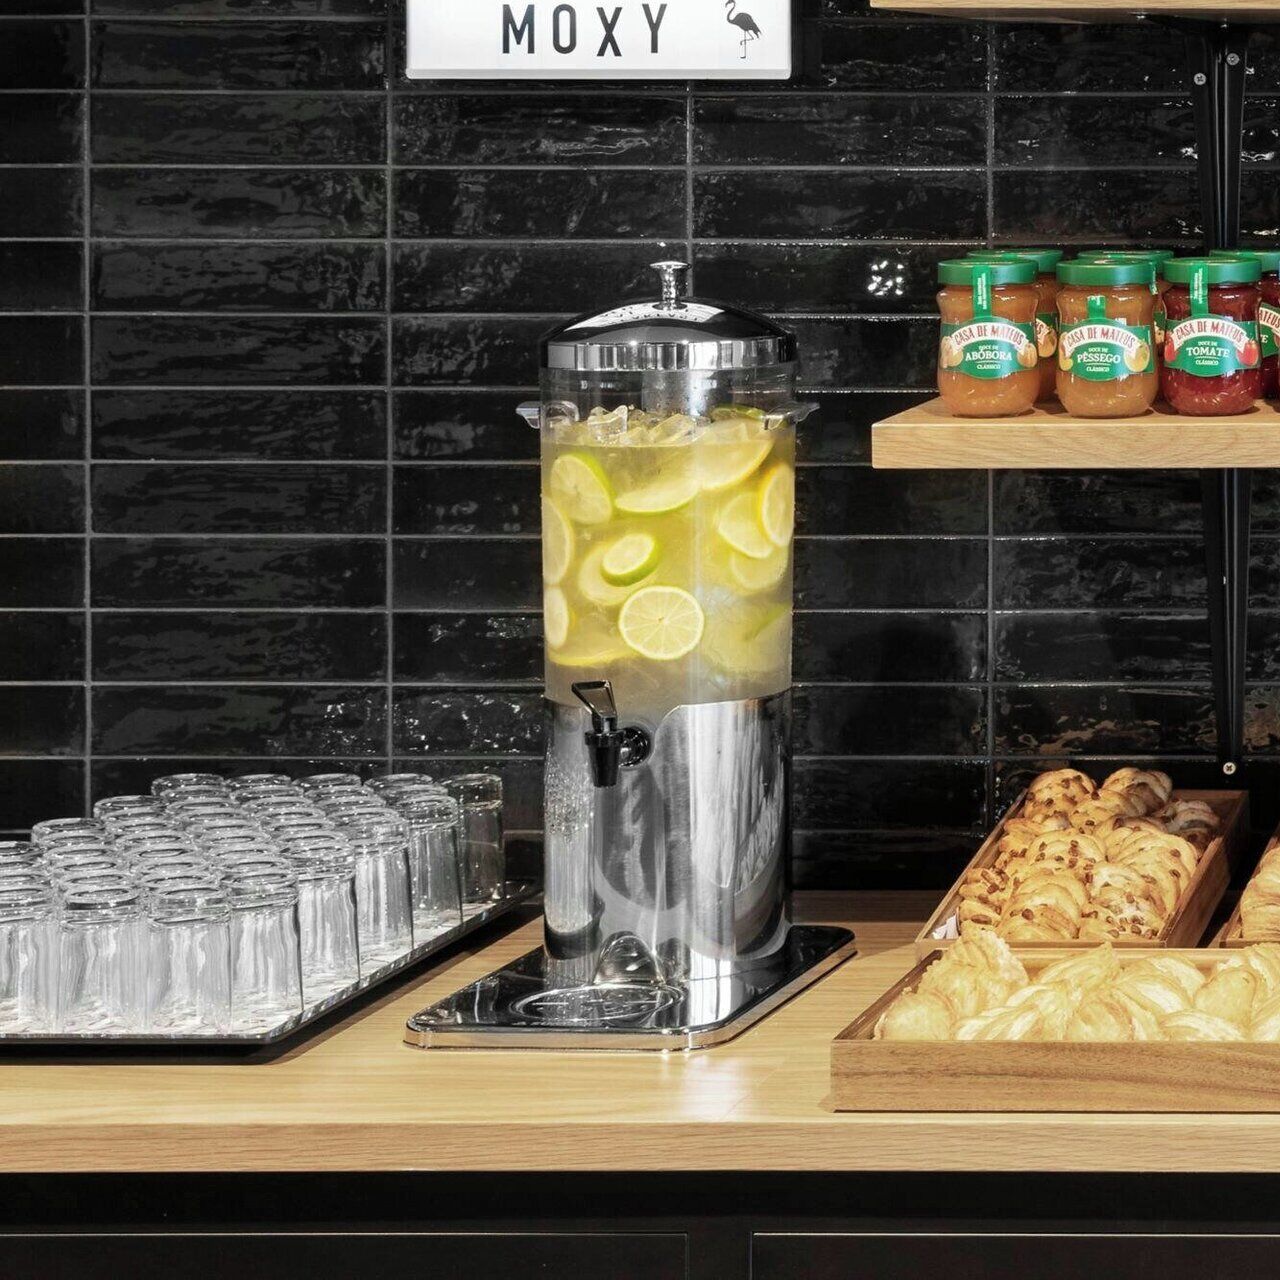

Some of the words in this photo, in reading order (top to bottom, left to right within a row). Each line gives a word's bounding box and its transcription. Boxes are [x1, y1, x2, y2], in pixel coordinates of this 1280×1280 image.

[502, 3, 668, 57] MOXY
[954, 327, 975, 345] CASA
[977, 324, 987, 336] DE
[991, 324, 1025, 345] MATEUS
[1066, 328, 1084, 347] CASA
[1087, 327, 1097, 338] DE
[1101, 327, 1136, 348] MATEUS
[1176, 322, 1196, 340] CASA
[1197, 321, 1207, 332] DE
[1211, 321, 1244, 342] MATEUS
[1186, 346, 1230, 358] TOMATE
